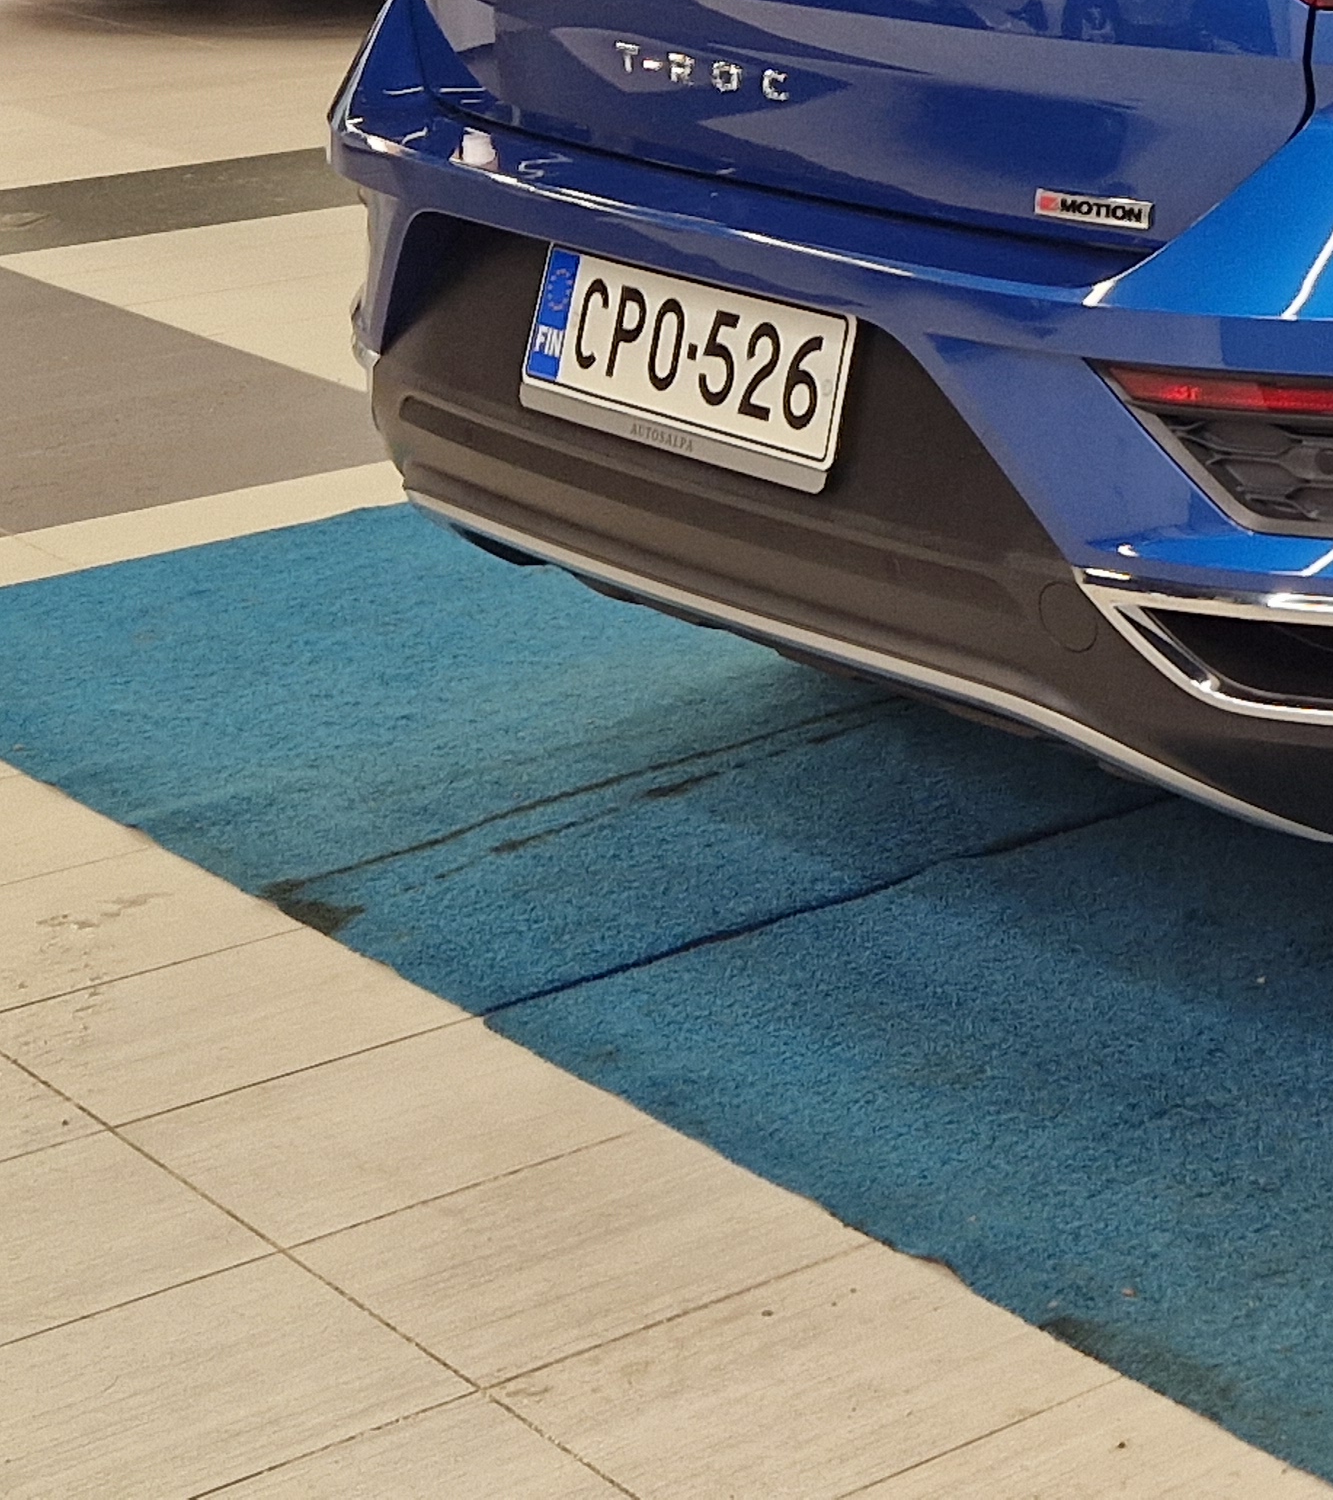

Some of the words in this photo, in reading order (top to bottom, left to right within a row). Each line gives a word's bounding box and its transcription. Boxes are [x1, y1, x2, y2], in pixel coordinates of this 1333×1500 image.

[614, 40, 790, 102] T-ROC
[534, 325, 564, 358] FIN
[574, 277, 825, 431] CPO-526
[629, 422, 694, 453] AUTOSALPA
